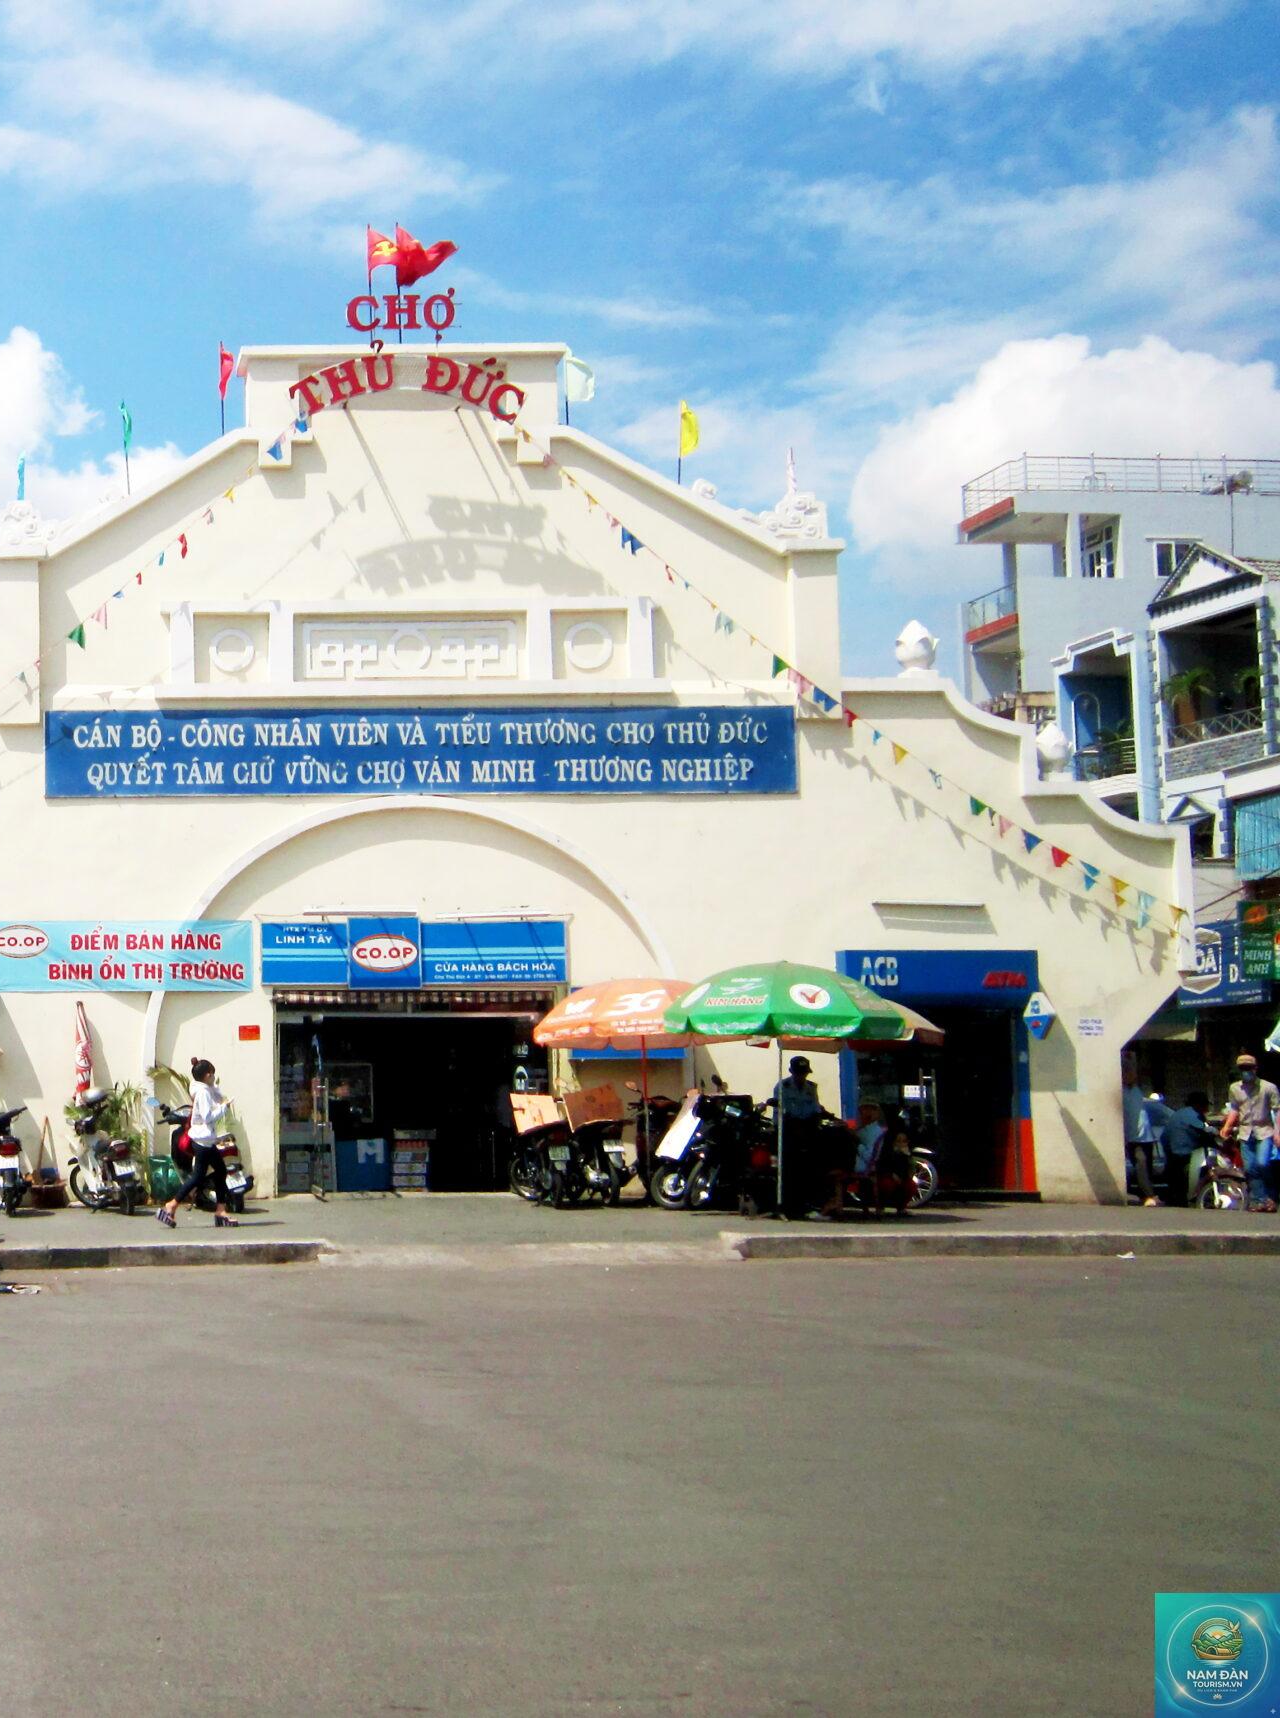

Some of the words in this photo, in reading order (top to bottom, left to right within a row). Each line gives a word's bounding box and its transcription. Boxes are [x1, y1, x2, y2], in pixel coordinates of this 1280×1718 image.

[345, 287, 456, 342] CHỢ
[288, 339, 395, 416] THỦ
[421, 356, 527, 425] ĐỨC
[73, 717, 121, 748] CÁN
[131, 718, 162, 752] BỘ
[181, 717, 246, 748] CÔNG
[254, 717, 322, 747] NHÂN
[330, 716, 389, 746] VIÊN
[396, 715, 427, 746] VÀ
[435, 712, 492, 745] TIỂU
[500, 718, 597, 745] THƯƠNG
[663, 712, 712, 745] THỦ
[717, 714, 769, 744] ĐỨC
[86, 752, 168, 791] QUYẾT
[172, 756, 225, 785] TÂM
[285, 754, 349, 785] VỮNG
[356, 758, 407, 789] CHỢ
[471, 759, 536, 783] MINH
[554, 754, 654, 783] THƯƠNG
[661, 752, 755, 787] NGHIỆP
[70, 924, 119, 951] ĐIỂM
[125, 929, 164, 950] BÁN
[171, 932, 221, 951] HÀNG
[275, 936, 305, 944] LINH
[309, 934, 333, 944] TÂY
[356, 947, 413, 959] CO.OP
[434, 962, 459, 972] CỬA
[462, 962, 494, 972] HÀNG
[497, 961, 529, 971] BÁCH
[531, 961, 556, 971] HÓA
[48, 962, 93, 980] BÌNH
[99, 954, 126, 980] ỔN
[131, 963, 163, 983] THỊ
[169, 957, 244, 981] TRƯỜNG
[860, 956, 899, 986] ACB
